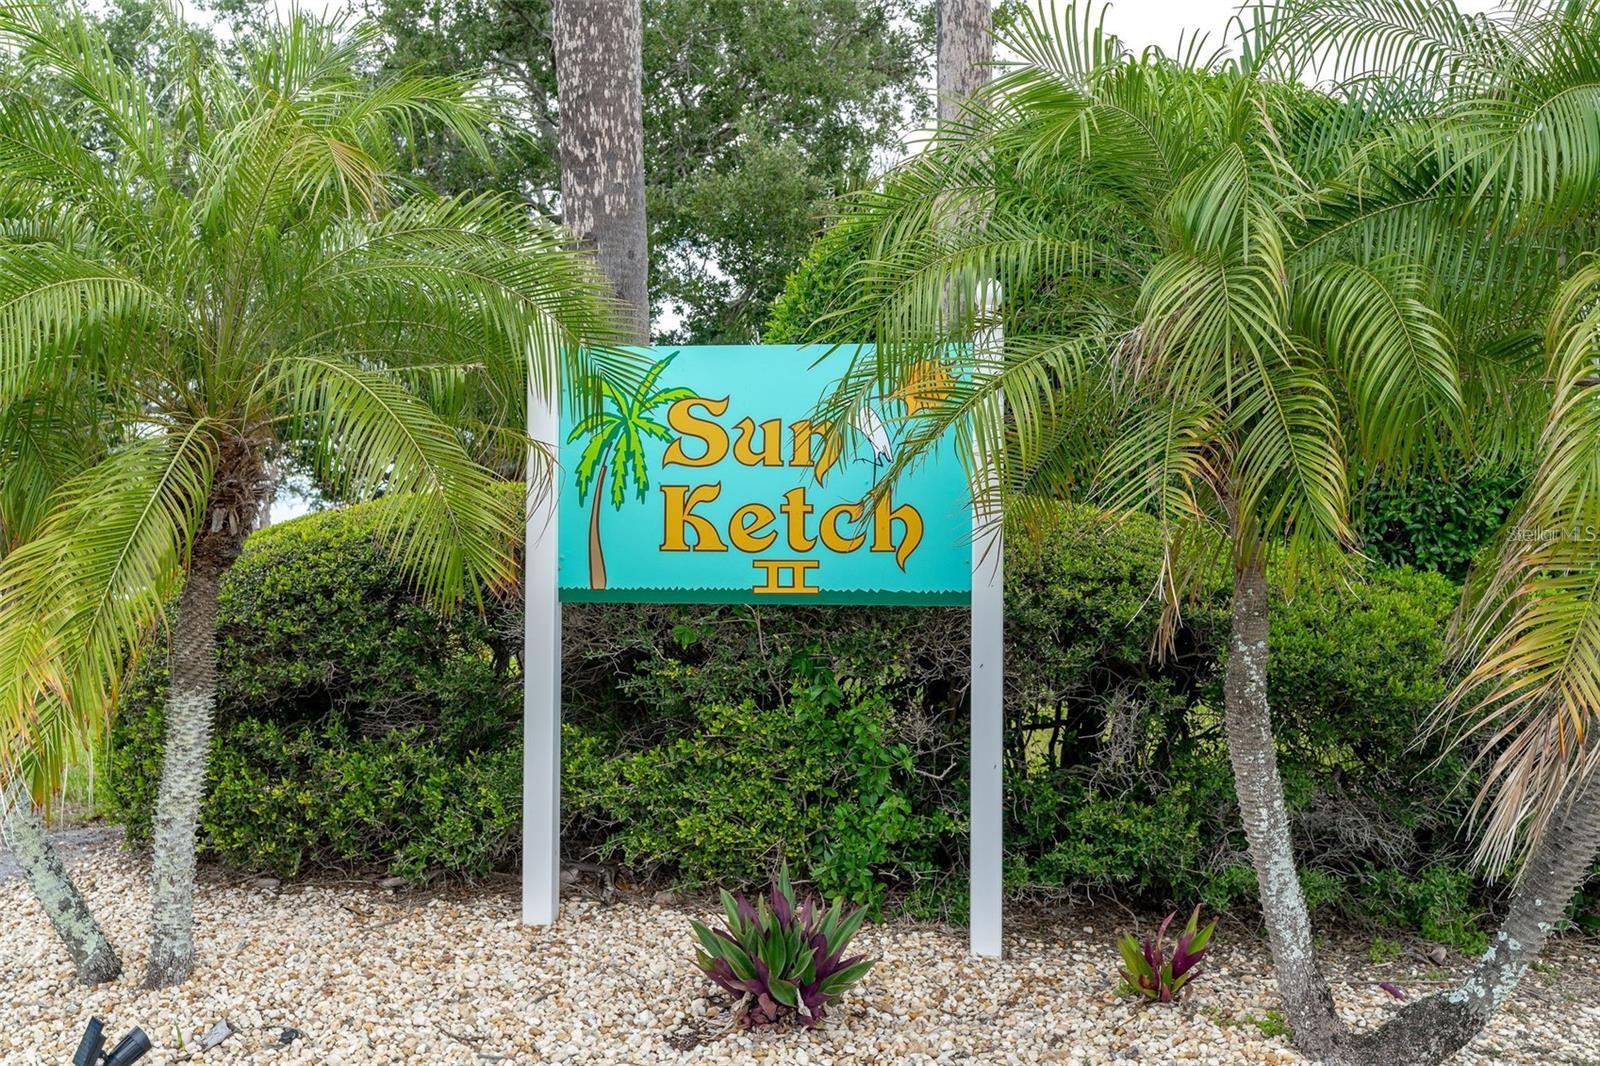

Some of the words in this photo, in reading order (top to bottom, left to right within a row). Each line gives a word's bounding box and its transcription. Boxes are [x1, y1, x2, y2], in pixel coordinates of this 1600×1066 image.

[662, 395, 844, 488] Sun
[659, 480, 925, 573] Ketch
[752, 559, 820, 594] II
